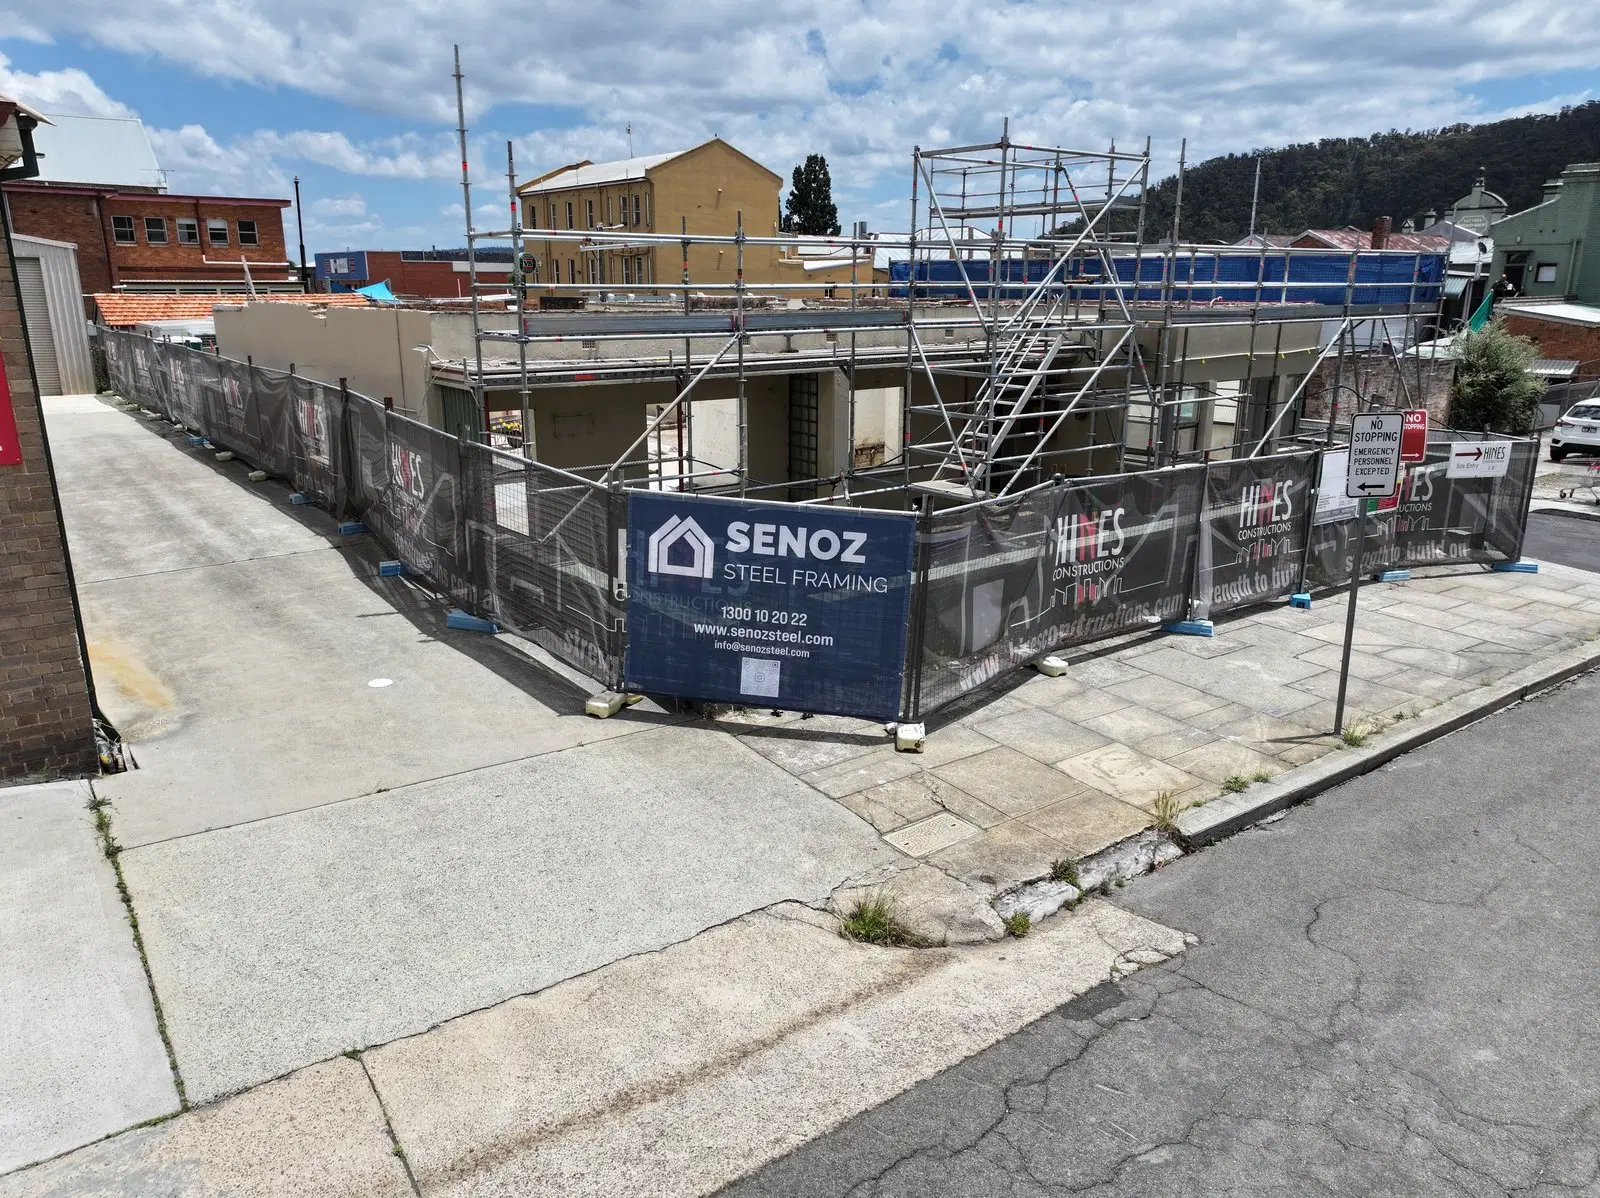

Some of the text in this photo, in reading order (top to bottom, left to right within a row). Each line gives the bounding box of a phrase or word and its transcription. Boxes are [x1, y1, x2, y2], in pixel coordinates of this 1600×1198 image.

[1370, 420, 1384, 430] NO
[1405, 414, 1422, 423] NO
[1354, 431, 1398, 443] STOPPING
[1353, 457, 1393, 466] PERSONNEL
[1354, 447, 1396, 456] EMERGENCY
[1483, 446, 1506, 460] HINES
[391, 442, 425, 500] HINES
[1355, 467, 1390, 476] EXCEPTED
[1239, 479, 1293, 529] HINES
[1055, 507, 1126, 567] HINES
[1238, 521, 1292, 541] CONSTRUCTIONS
[724, 521, 868, 564] SENOZ
[1450, 542, 1468, 560] on
[723, 564, 889, 594] STEEL FRAMING
[1053, 556, 1126, 582] CONSTRUCTIONS
[1255, 571, 1268, 593] to
[720, 606, 808, 627] 1300 10 20 22
[693, 623, 834, 646] www.senozsteel.com
[714, 639, 810, 658] info@senozsteel.com
